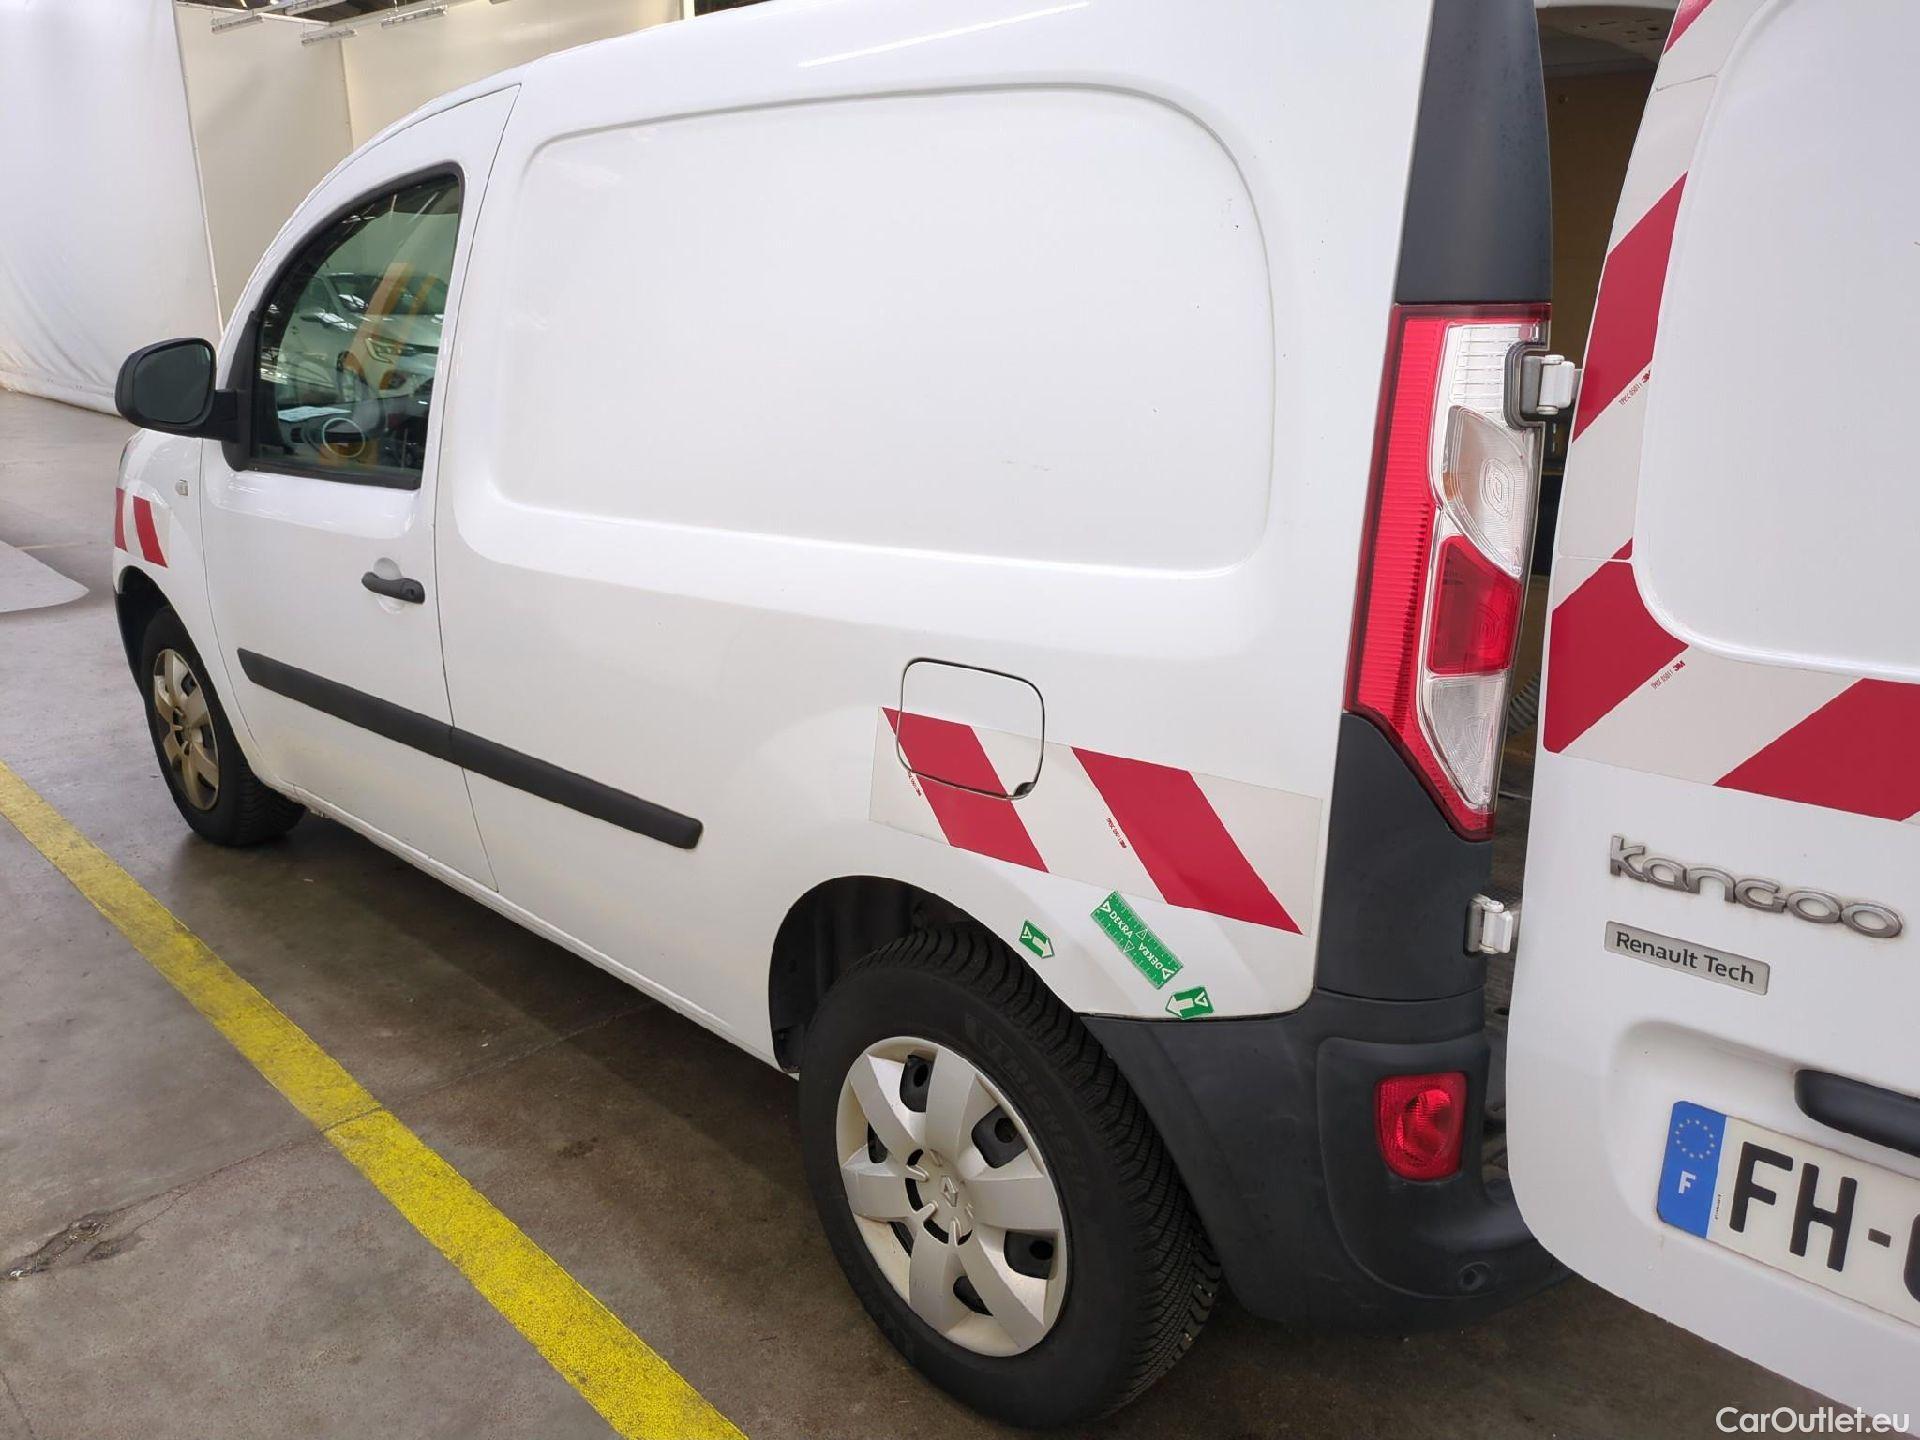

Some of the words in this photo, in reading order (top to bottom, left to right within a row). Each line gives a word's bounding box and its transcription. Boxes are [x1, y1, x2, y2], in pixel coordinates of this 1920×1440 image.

[1672, 660, 1686, 672] 3M
[1109, 911, 1133, 939] DEKRA
[1138, 941, 1164, 970] DEKRA
[1615, 931, 1698, 969] Renault
[1704, 954, 1755, 985] Tech
[1678, 1170, 1697, 1194] F
[1729, 1140, 1920, 1305] FH-
